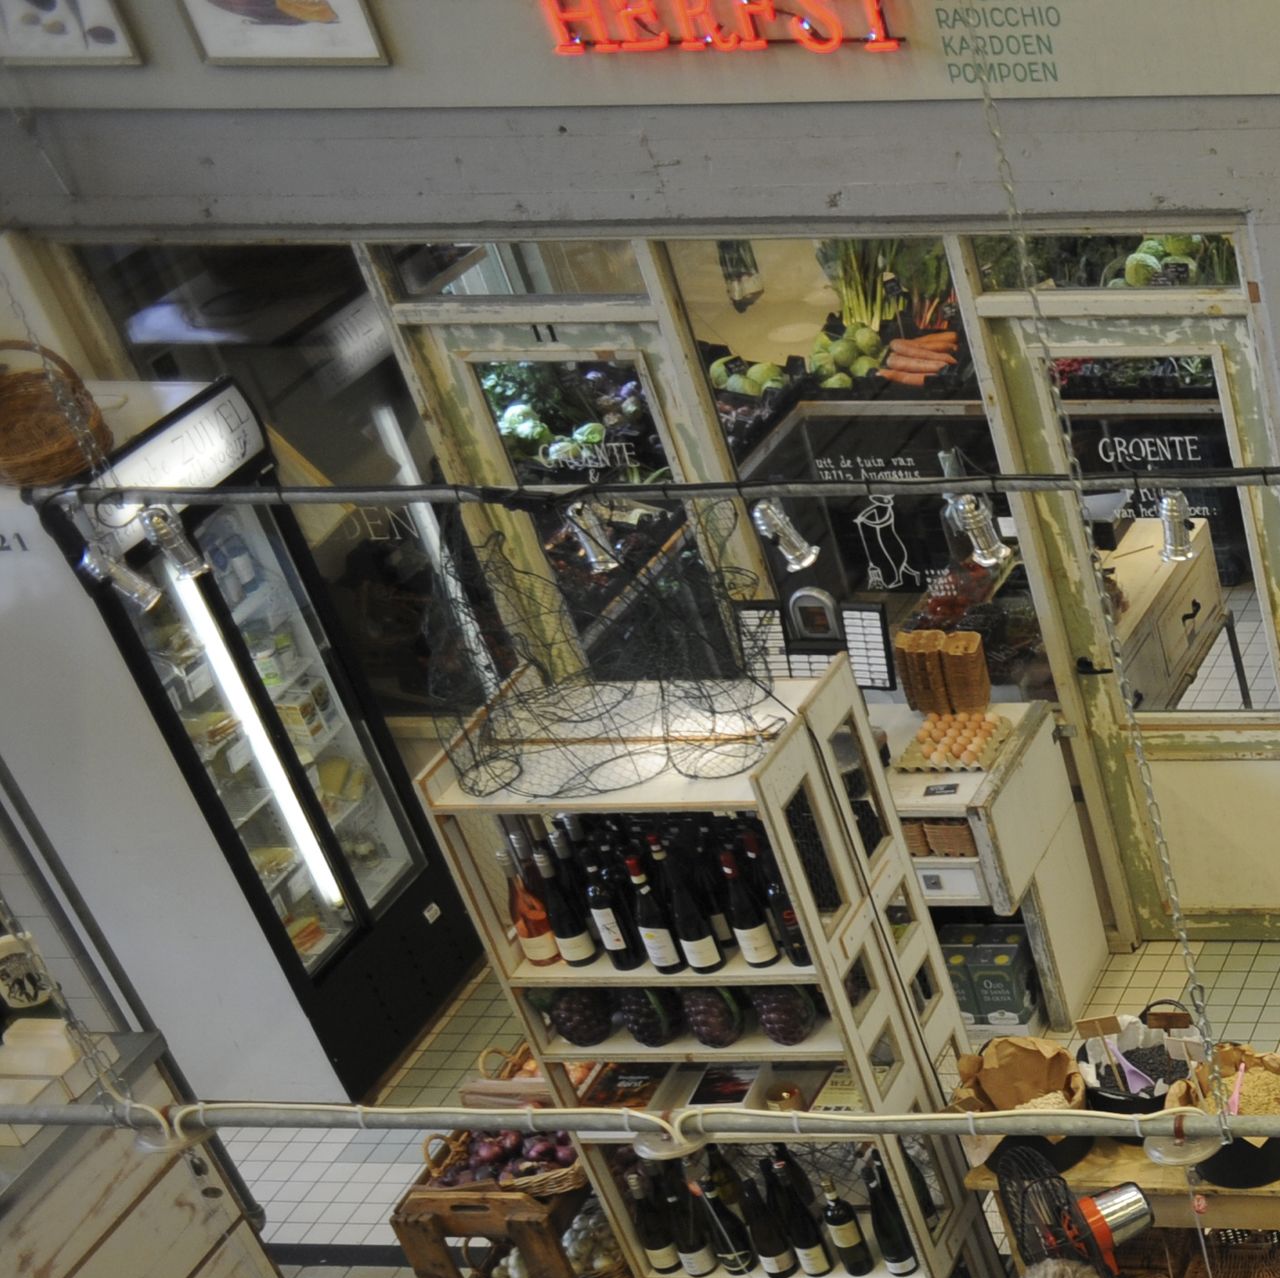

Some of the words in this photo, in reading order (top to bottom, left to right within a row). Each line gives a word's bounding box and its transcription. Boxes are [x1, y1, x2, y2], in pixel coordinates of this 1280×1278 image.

[935, 6, 1061, 28] RADICCHIO
[942, 35, 1053, 56] KARDOEN
[947, 63, 1058, 84] POMPOEN
[1098, 435, 1202, 463] GROENTE
[856, 455, 886, 468] tuin
[891, 455, 916, 467] van
